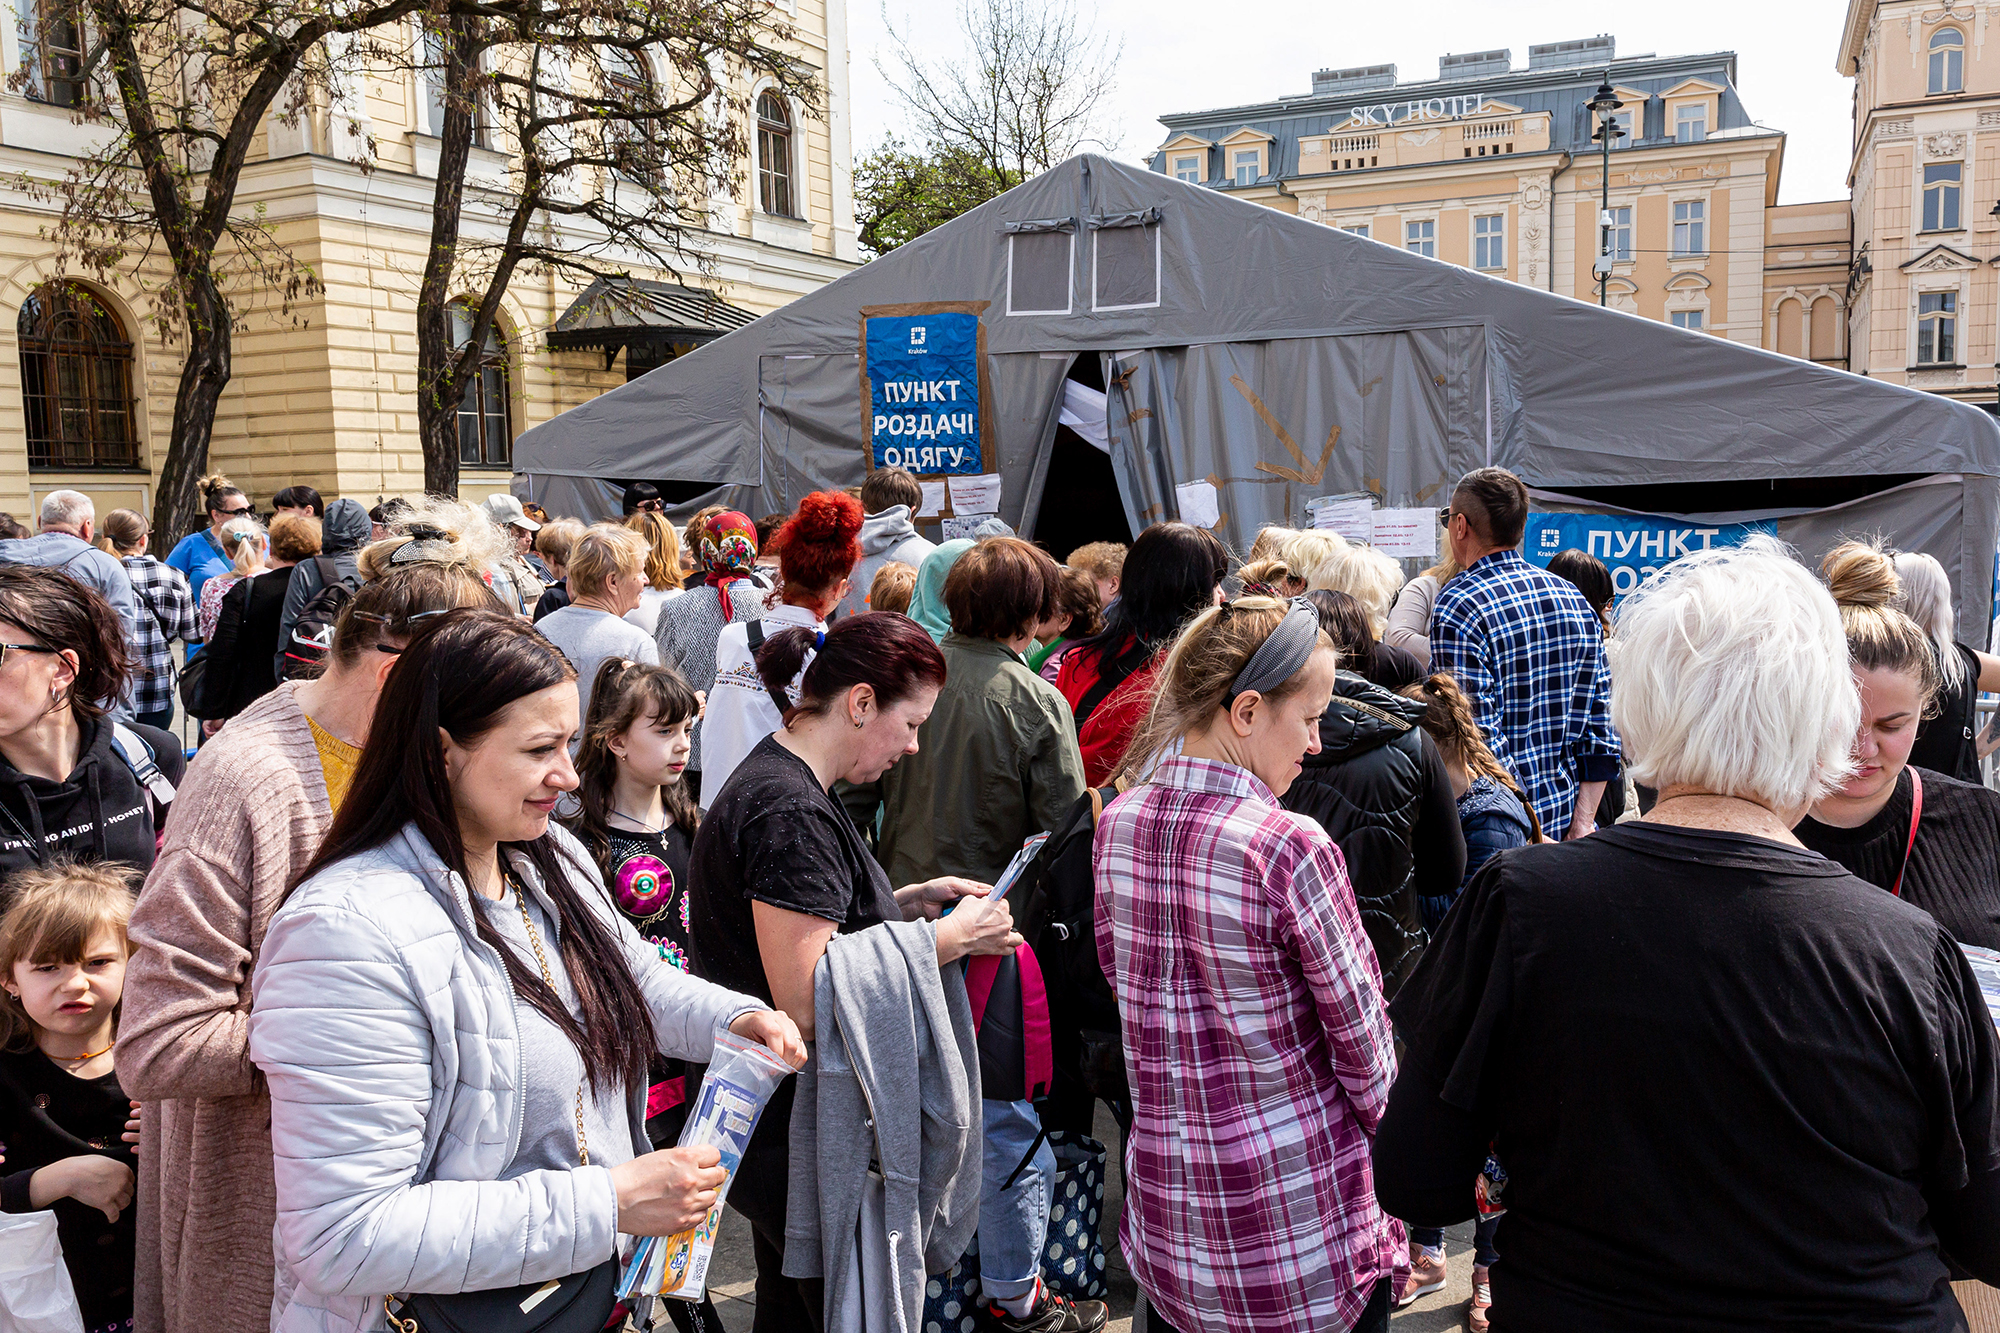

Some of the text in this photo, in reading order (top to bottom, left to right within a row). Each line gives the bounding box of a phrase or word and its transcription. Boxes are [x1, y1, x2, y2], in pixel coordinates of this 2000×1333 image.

[1350, 93, 1492, 128] SKY HOTEL
[884, 380, 961, 403] ПУНКТ
[874, 413, 974, 440] РОЗДАЧІ
[884, 446, 964, 472] ОДЯГУ
[1588, 529, 1719, 558] ПУНКТ
[61, 827, 77, 839] AN
[108, 806, 144, 824] HONEY
